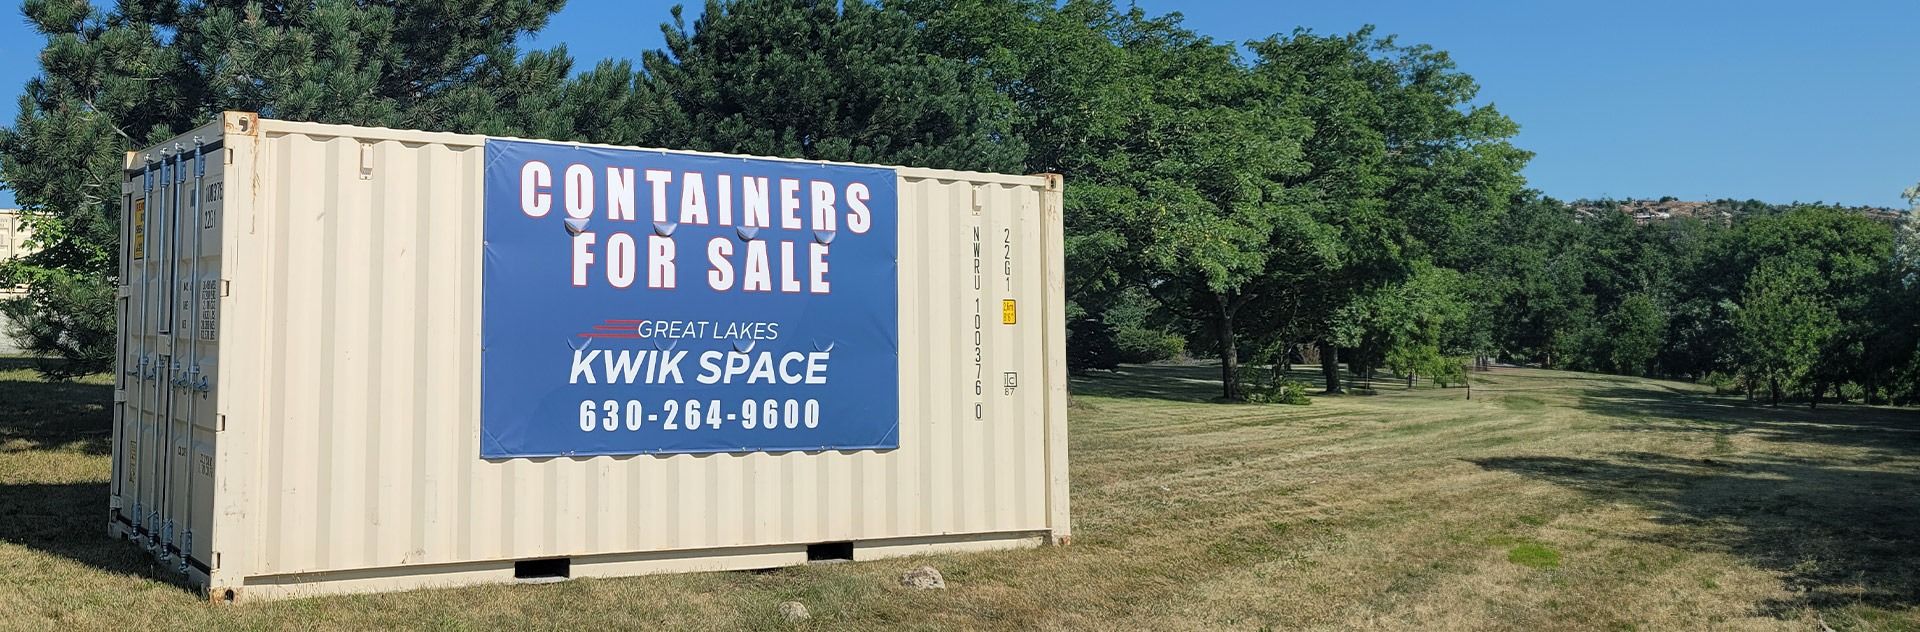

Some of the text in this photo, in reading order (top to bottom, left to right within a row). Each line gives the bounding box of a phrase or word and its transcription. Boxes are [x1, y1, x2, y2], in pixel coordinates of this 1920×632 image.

[520, 160, 872, 234] CONTAINERS
[571, 231, 831, 293] FOR SALE
[638, 320, 779, 340] GREAT LAKES
[973, 226, 983, 420] NWRU 100376 0
[568, 350, 830, 385] KWIK SPACE
[579, 399, 820, 432] 630-264-9600
